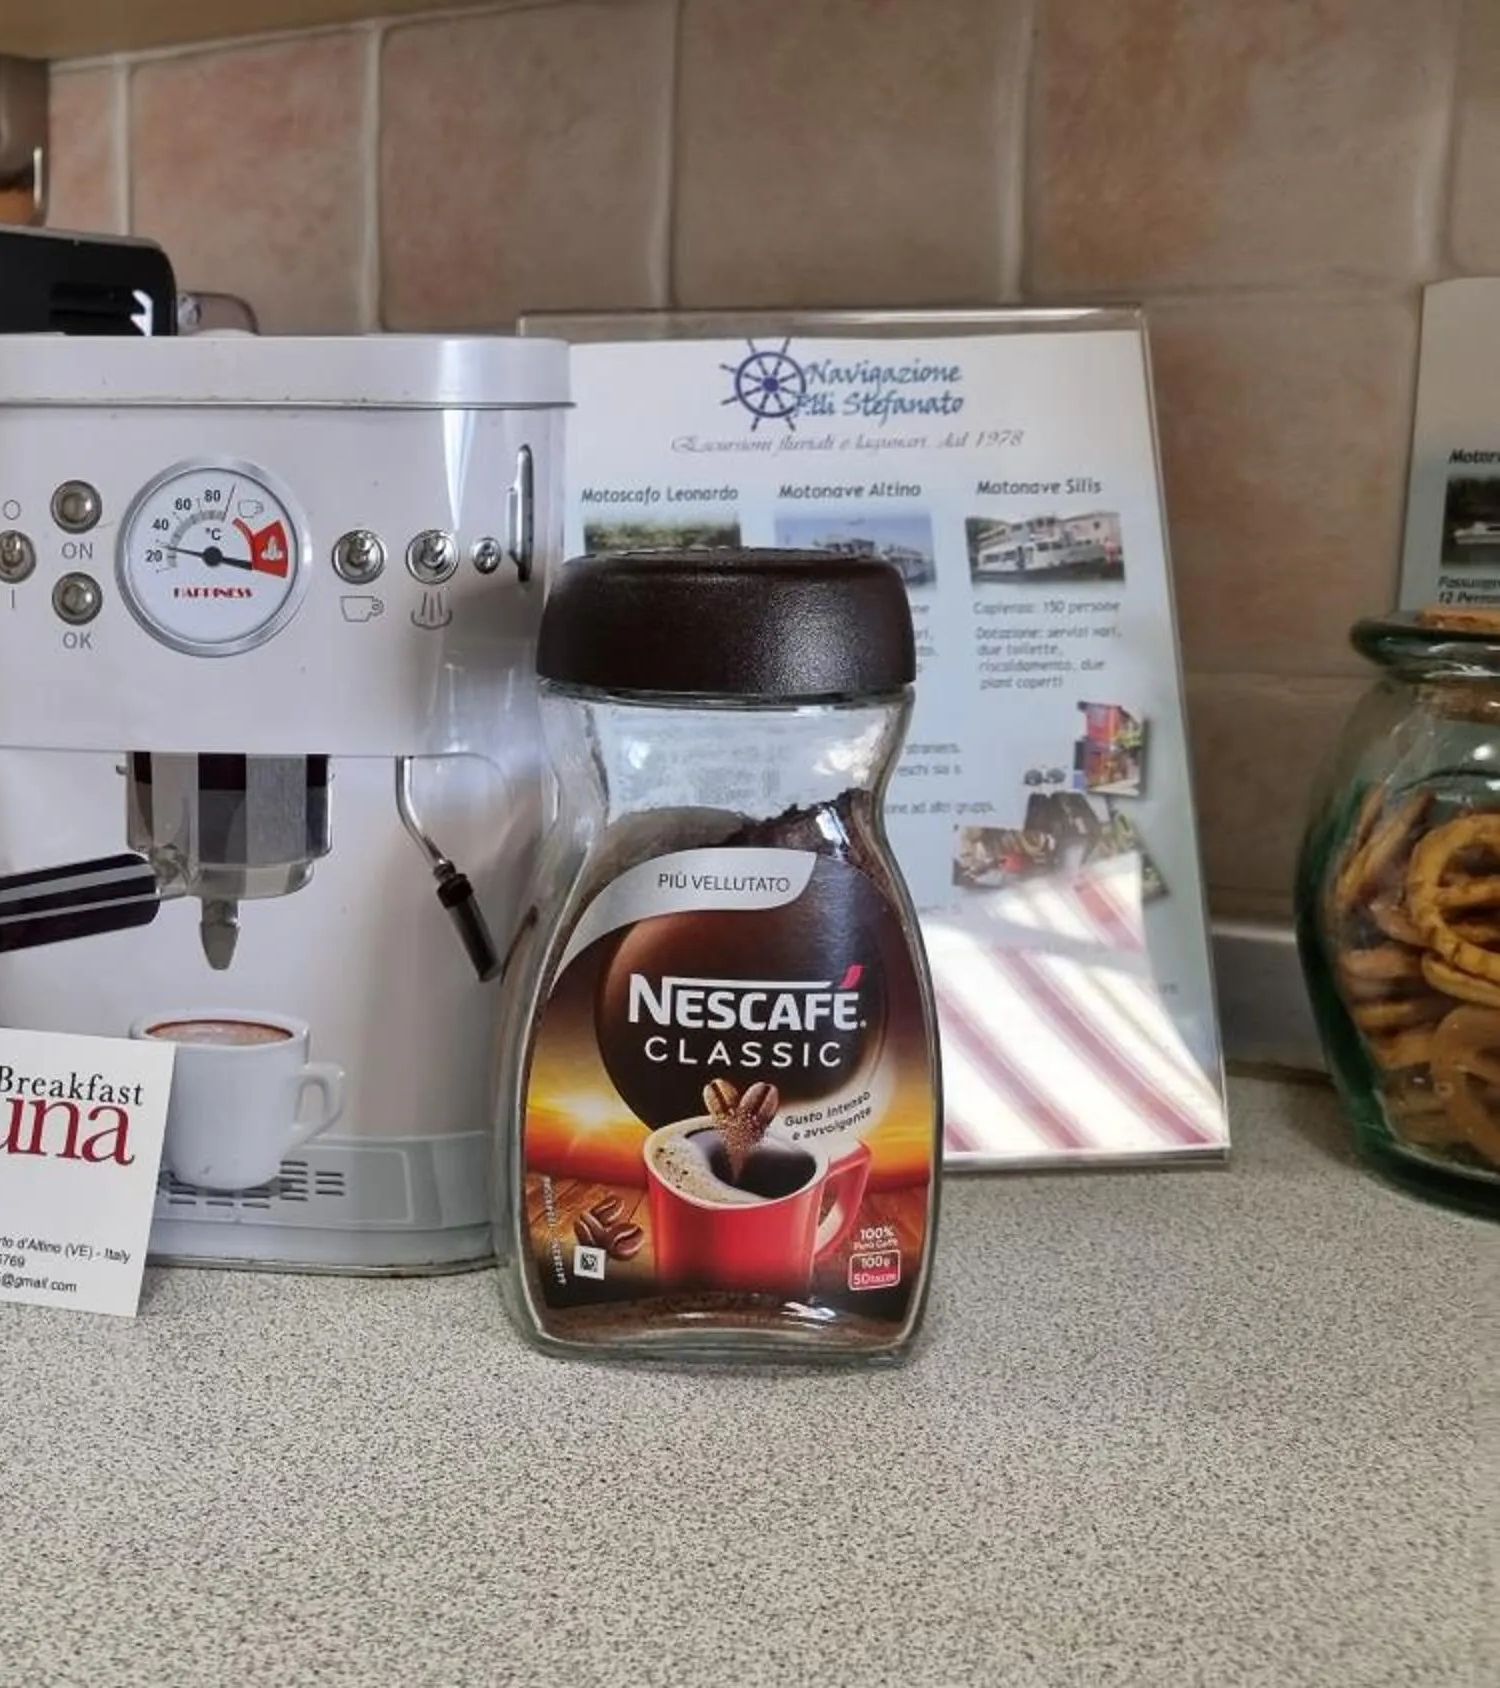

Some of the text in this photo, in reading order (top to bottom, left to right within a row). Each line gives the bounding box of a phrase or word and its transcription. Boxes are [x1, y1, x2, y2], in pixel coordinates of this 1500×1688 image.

[804, 358, 963, 394] Navigazione
[841, 389, 964, 428] Stefanato
[975, 430, 1025, 449] 1978
[204, 489, 221, 503] 80
[581, 485, 739, 505] Motoscafo Leonardo
[778, 481, 922, 500] Motonave Altino
[976, 477, 1102, 496] Motonave Silis
[175, 498, 192, 511] 60
[152, 518, 169, 531] 40
[61, 541, 94, 560] ON
[145, 549, 163, 562] 20
[173, 587, 253, 598] HAPPINESS
[1043, 600, 1064, 614] 150
[1068, 601, 1121, 616] persone
[62, 631, 93, 649] OK
[658, 872, 791, 894] PIÙ VELLUTATO
[627, 964, 864, 1031] NESCAFÉ
[644, 1036, 842, 1068] CLASSIC
[784, 1111, 823, 1127] Gusto
[803, 1106, 872, 1139] avvolgente
[860, 1225, 895, 1240] 100%
[17, 1238, 62, 1255] d'Altino
[66, 1243, 93, 1261] (VE)
[104, 1248, 131, 1265] Italy
